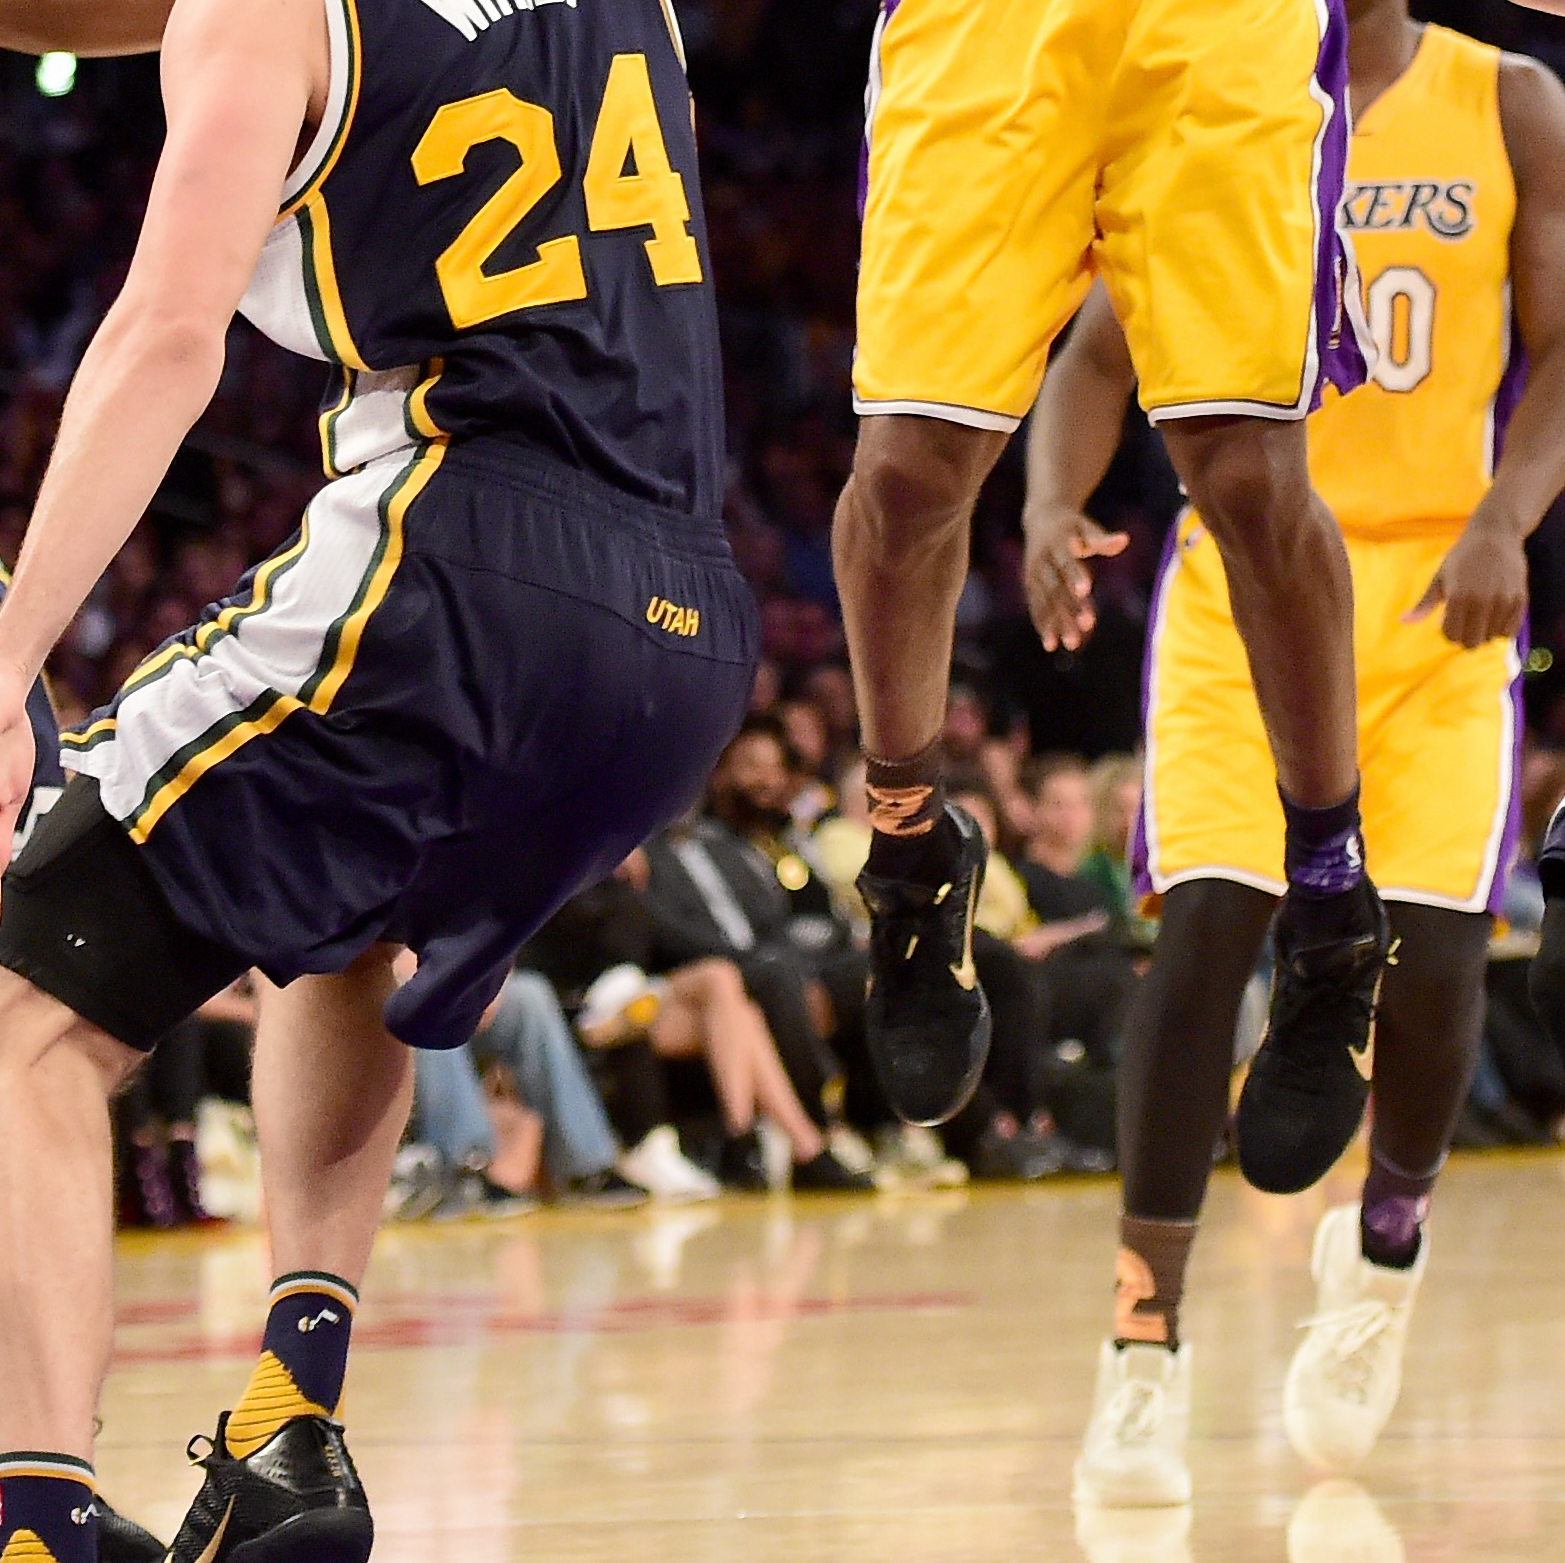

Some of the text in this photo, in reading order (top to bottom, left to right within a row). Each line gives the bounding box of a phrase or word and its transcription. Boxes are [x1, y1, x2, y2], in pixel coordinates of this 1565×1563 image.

[410, 53, 704, 329] 24
[1340, 184, 1474, 238] KERS
[1367, 266, 1435, 392] 0
[646, 595, 700, 637] UTAH
